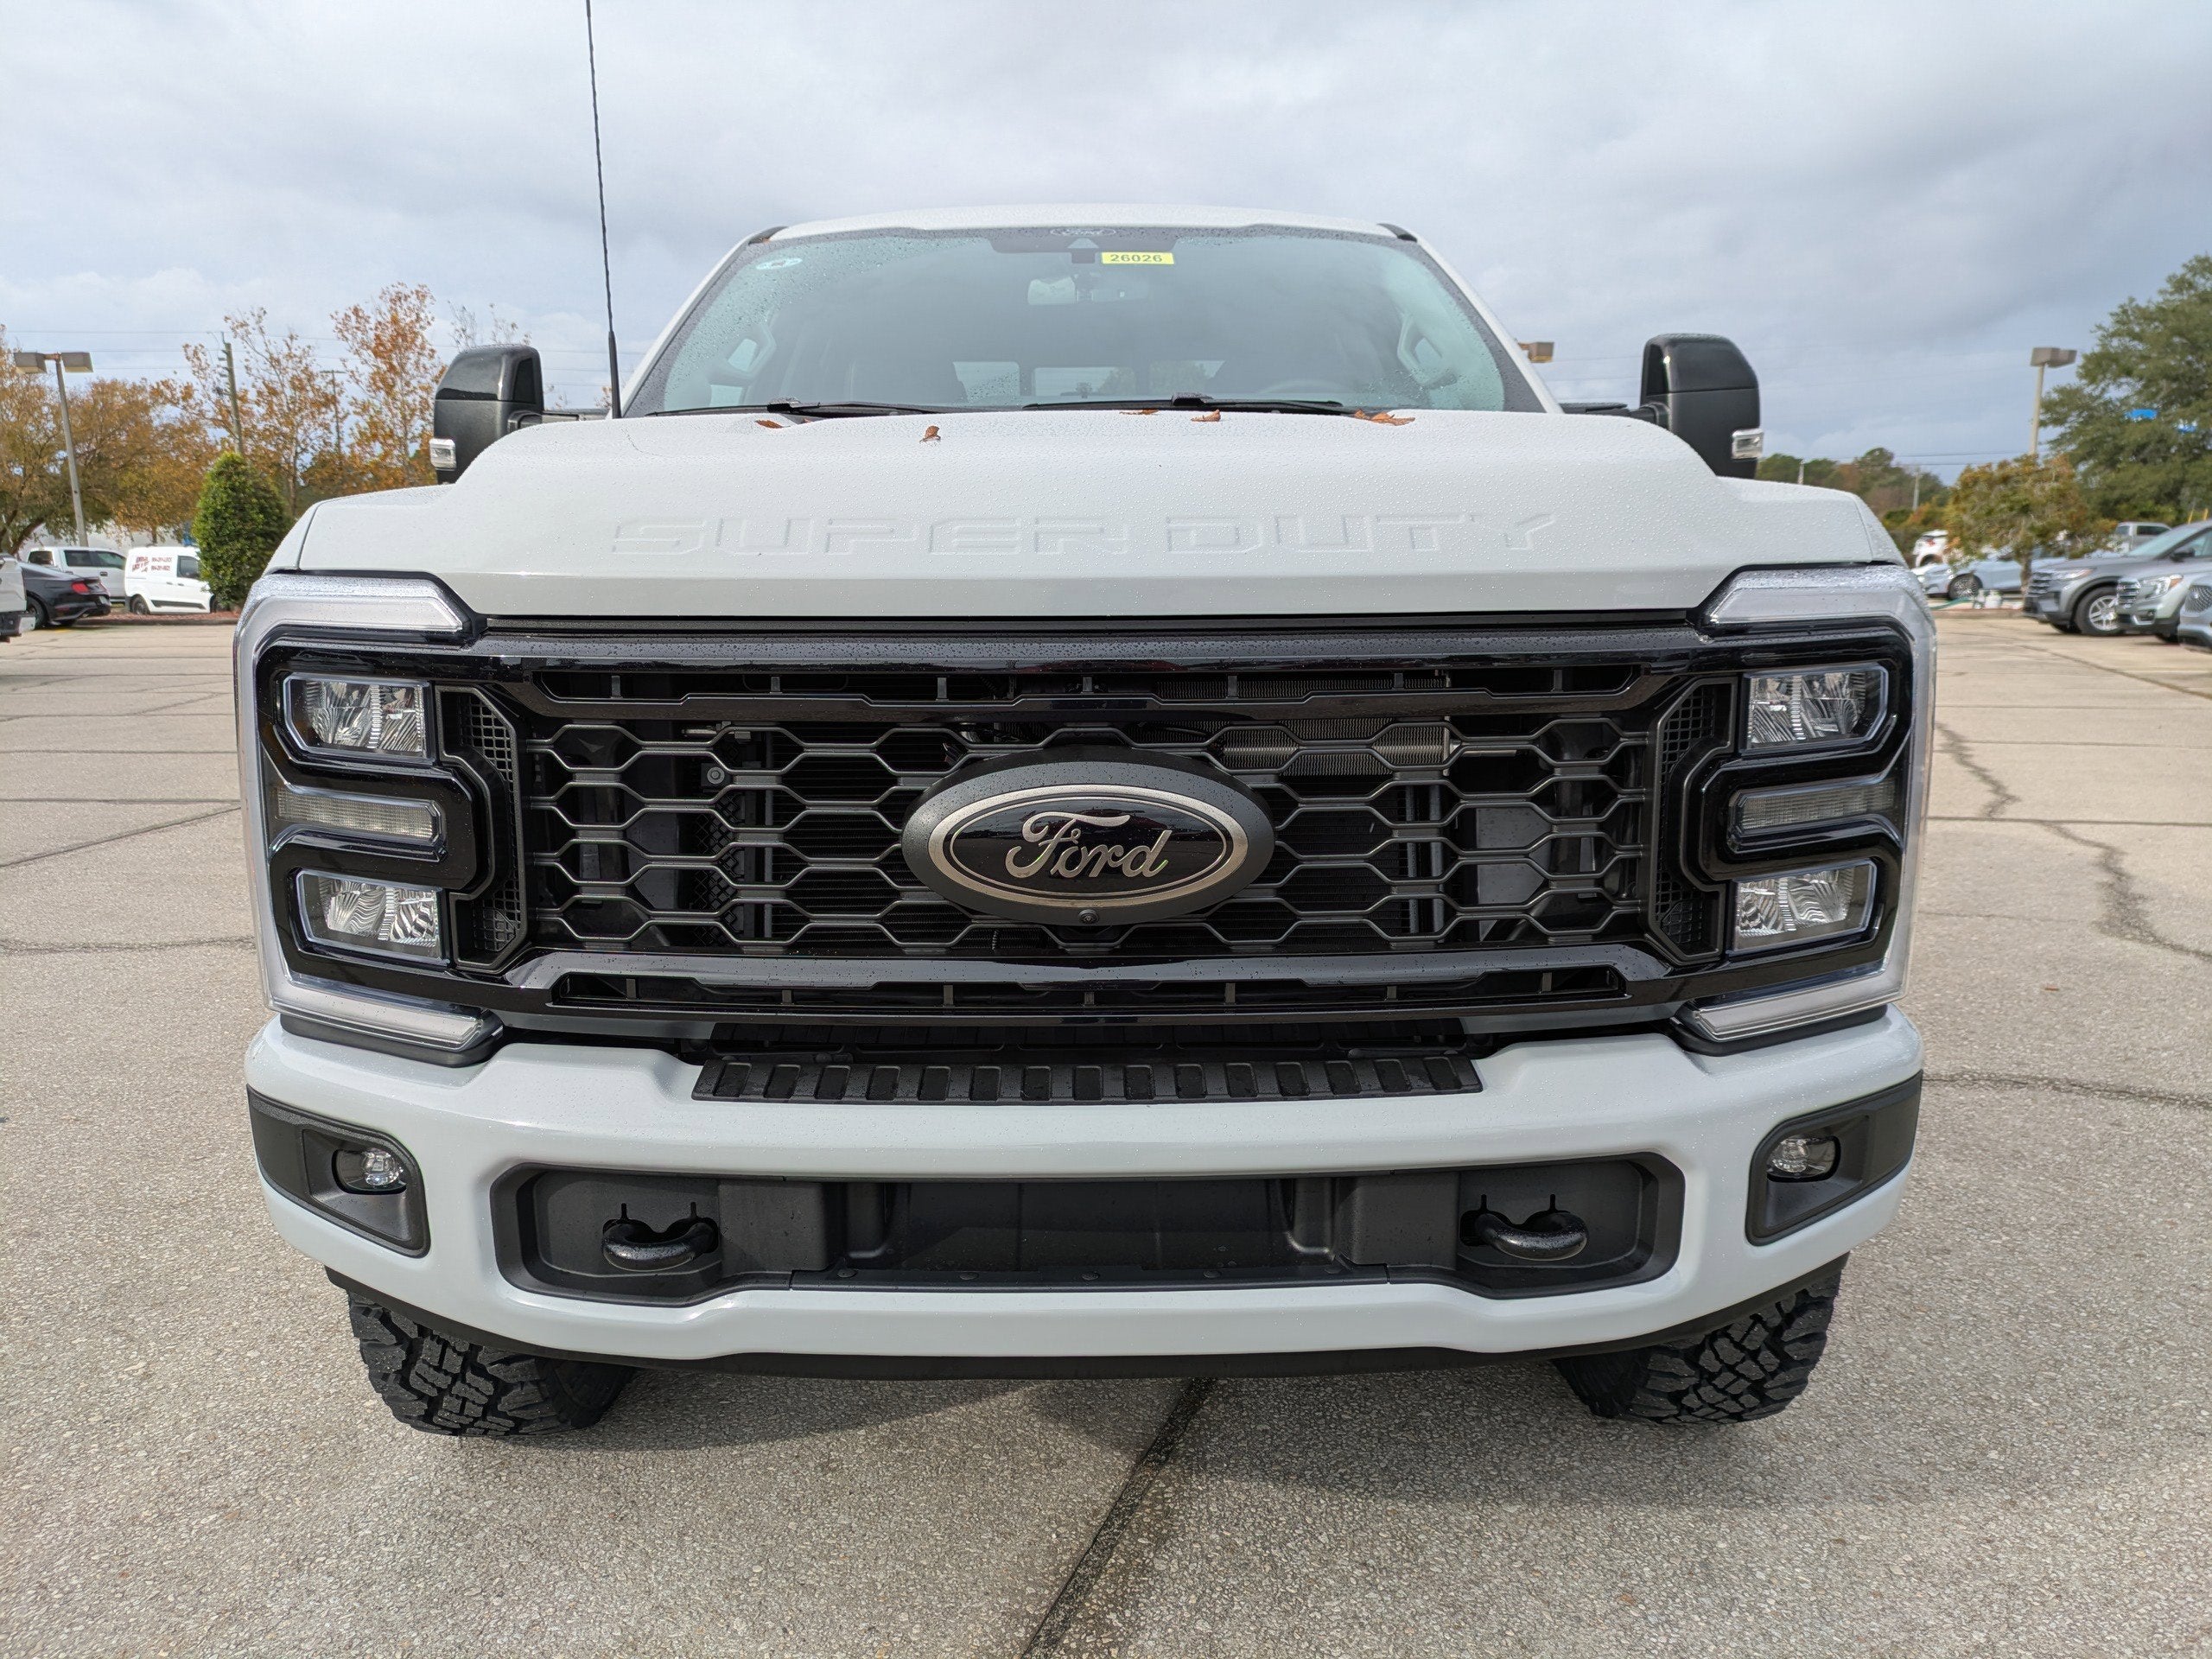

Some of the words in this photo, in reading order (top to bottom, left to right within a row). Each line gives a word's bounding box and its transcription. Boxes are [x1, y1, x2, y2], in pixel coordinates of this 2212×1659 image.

[1109, 254, 1163, 263] 26026
[612, 516, 1129, 555] SUPER
[1165, 513, 1555, 554] DUTY
[1005, 810, 1173, 878] Ford
